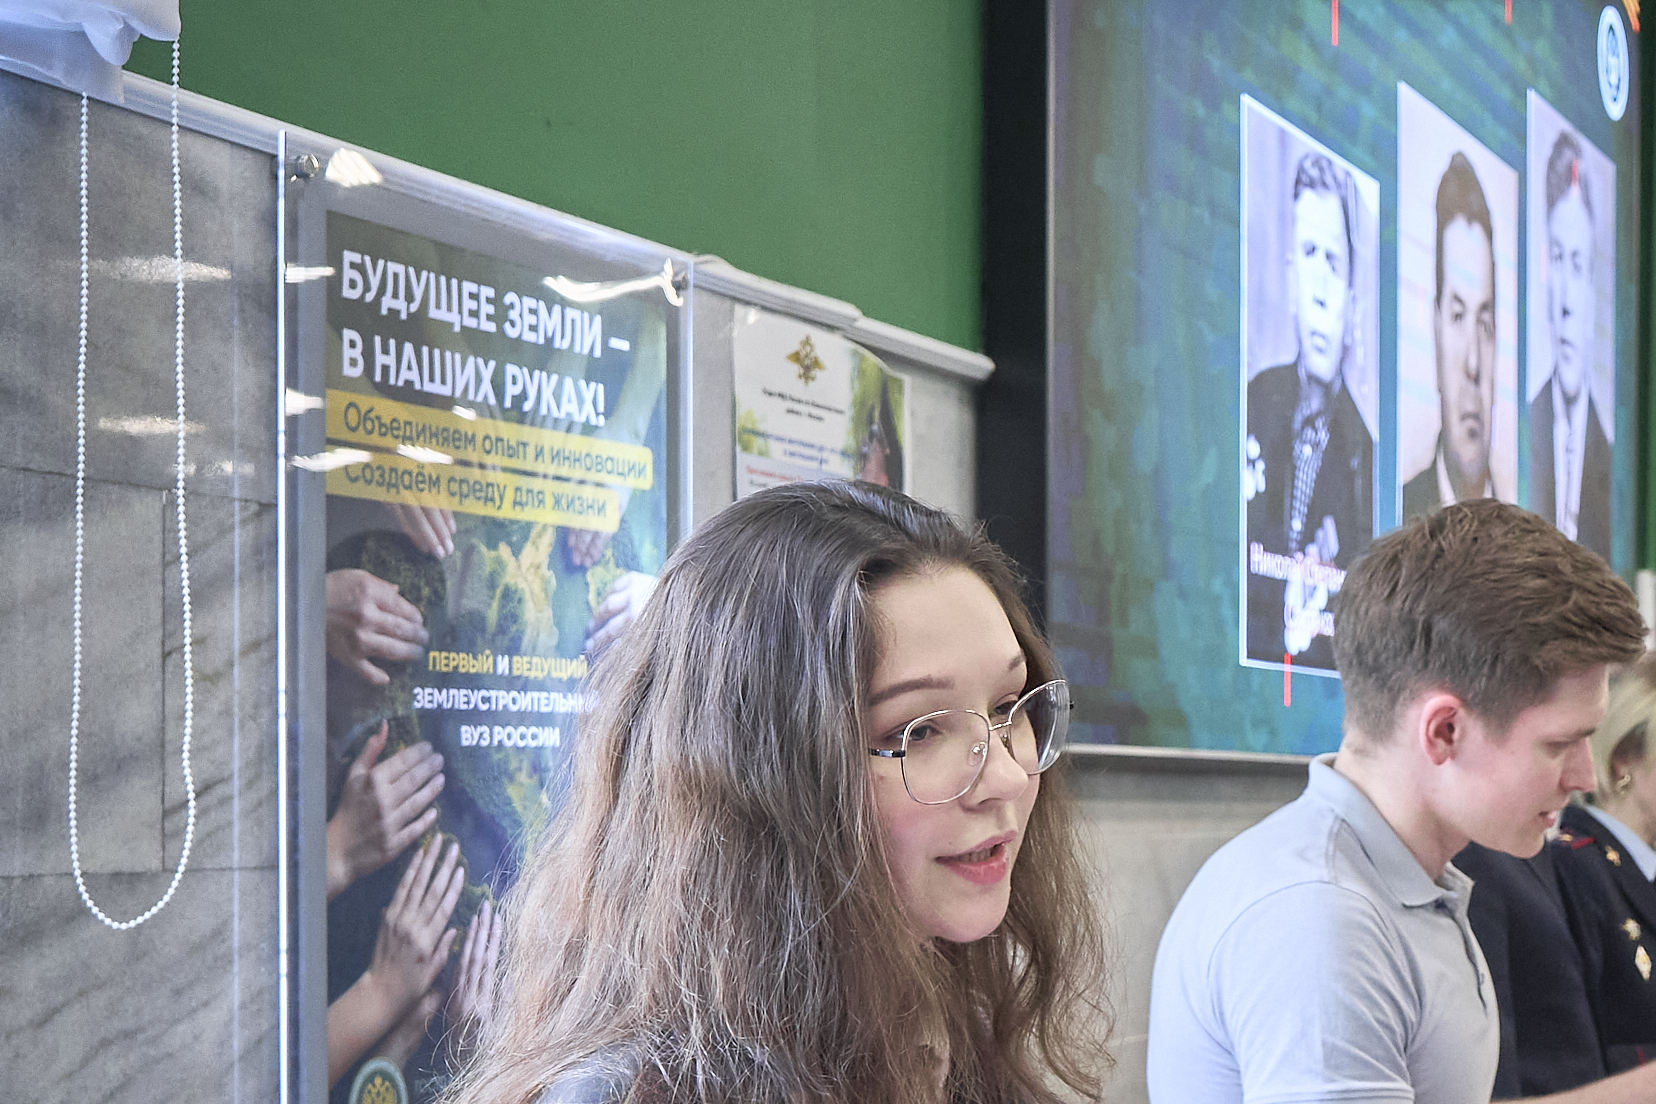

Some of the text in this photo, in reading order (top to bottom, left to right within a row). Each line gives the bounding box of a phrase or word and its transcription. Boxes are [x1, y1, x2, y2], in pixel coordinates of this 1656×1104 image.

[341, 249, 497, 333] БУДУЩЕЕ
[503, 291, 602, 358] ЗЕМЛИ
[341, 328, 605, 427] В НАШИХ РУКАХ!
[343, 401, 649, 481] Объединяем опыт и инновации
[344, 463, 608, 518] Создаём среду для жизни
[428, 649, 588, 681] ПЕРВЫЙ И ВЕДУЩИЙ
[460, 725, 561, 748] ВУЗ РОССИИ
